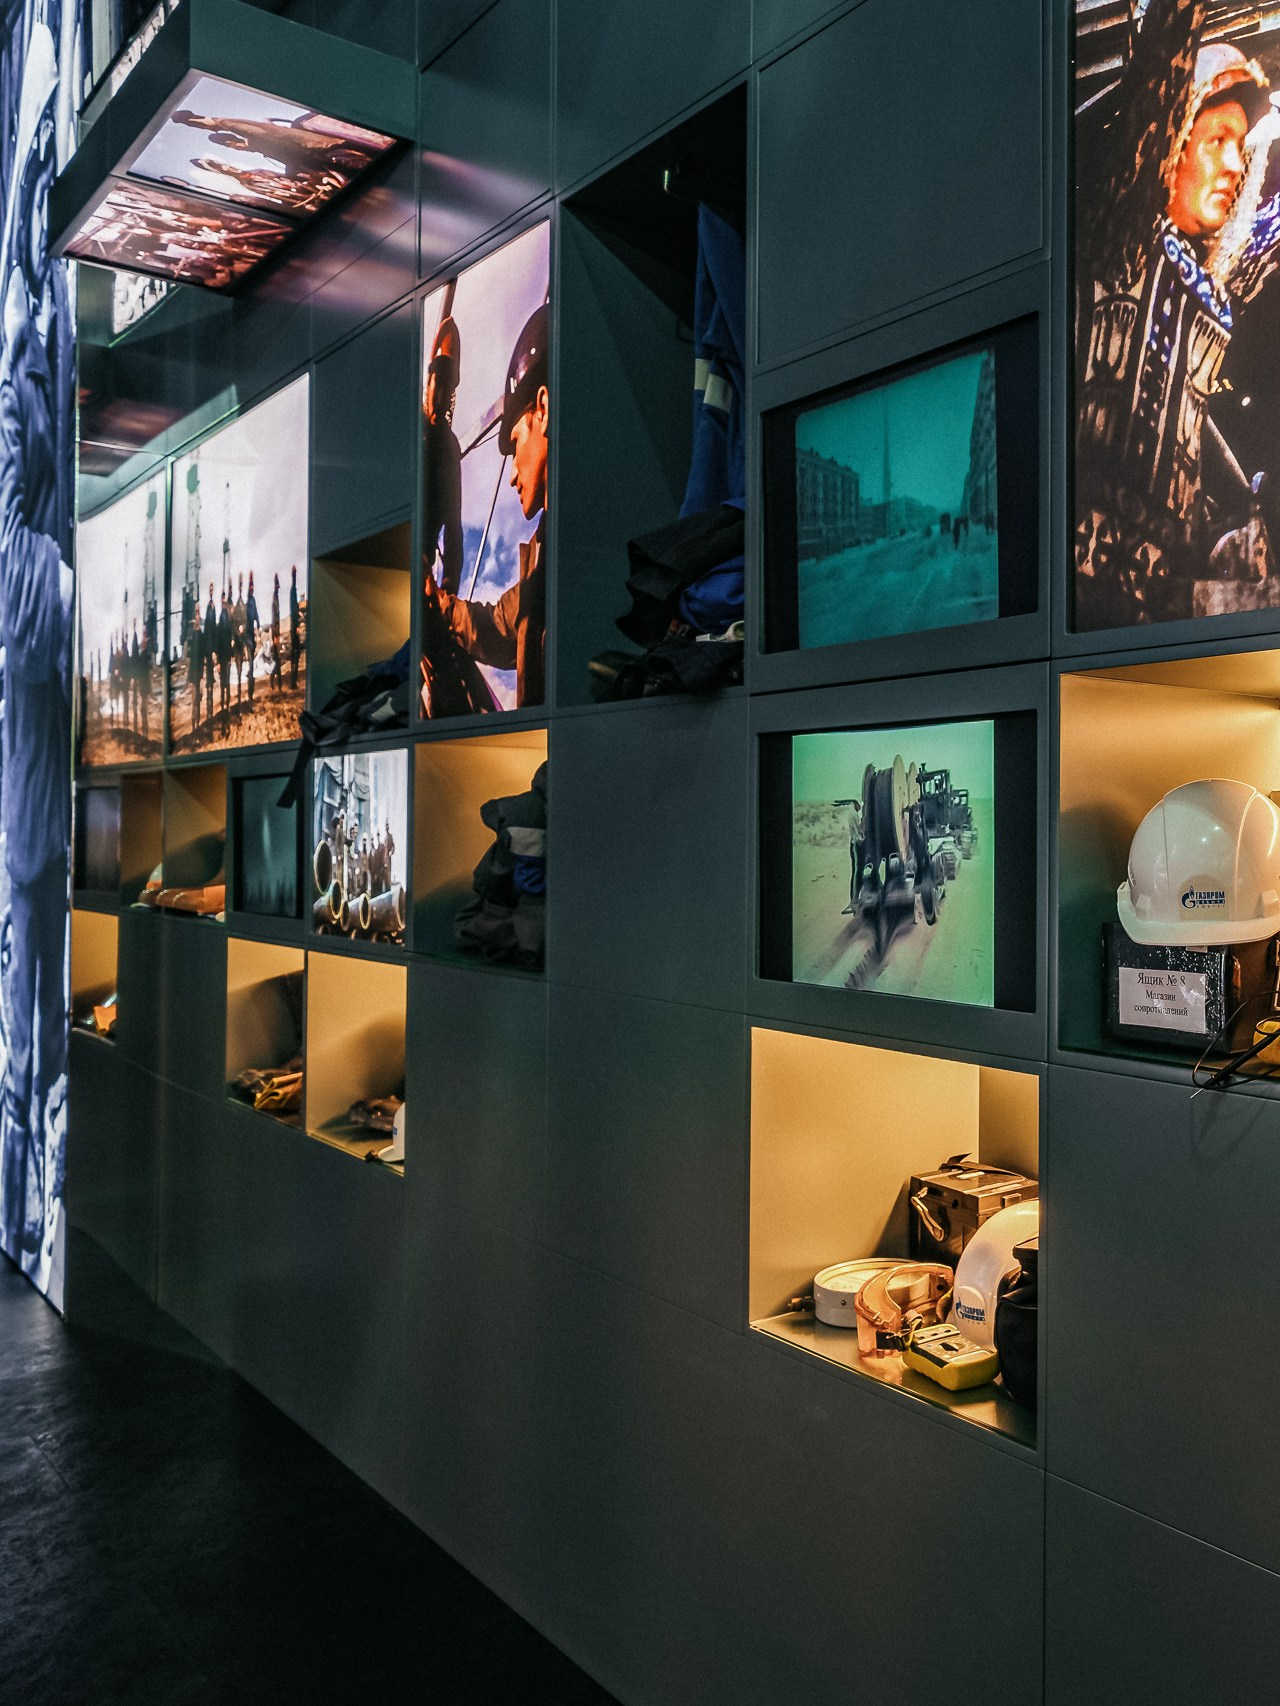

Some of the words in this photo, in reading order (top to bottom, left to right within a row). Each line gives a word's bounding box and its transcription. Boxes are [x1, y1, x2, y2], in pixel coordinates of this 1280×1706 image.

[1195, 891, 1225, 899] ГАЗПРОМ
[1137, 973, 1164, 986] Ящик
[1166, 974, 1177, 986] №
[1180, 976, 1186, 986] 8
[1145, 990, 1176, 1001] Магазин
